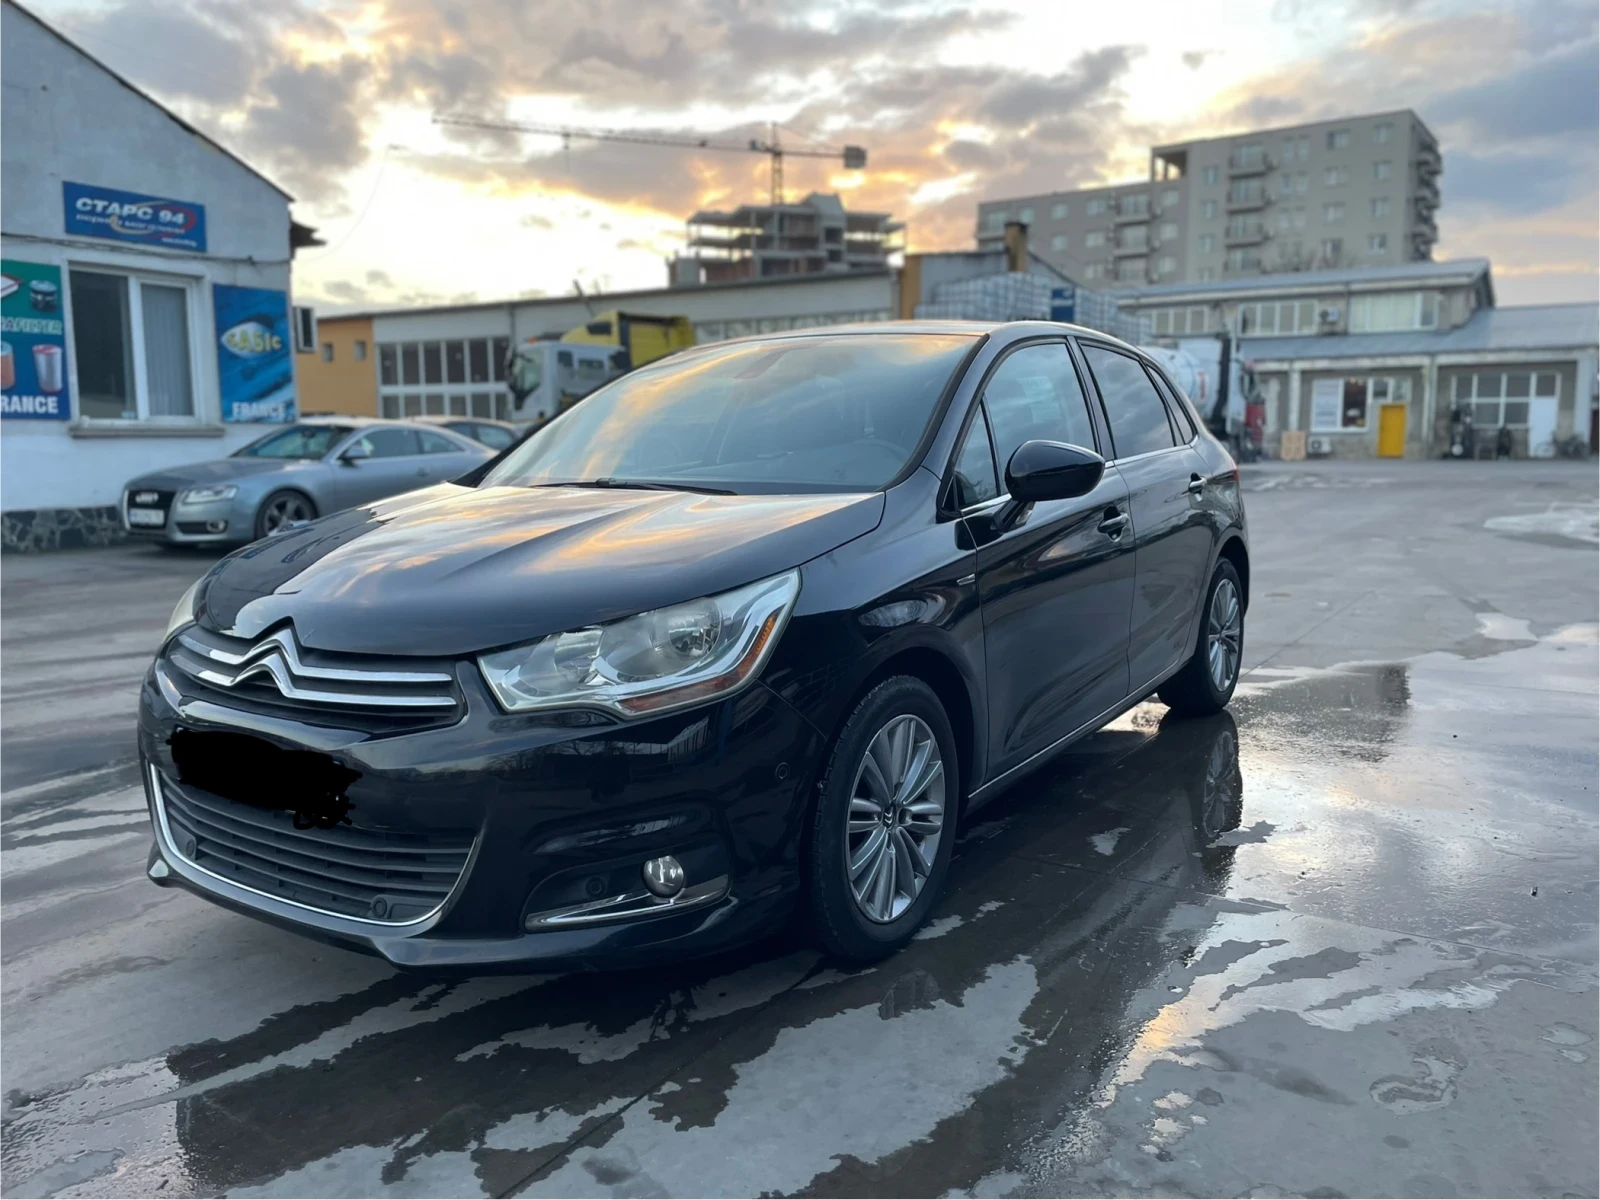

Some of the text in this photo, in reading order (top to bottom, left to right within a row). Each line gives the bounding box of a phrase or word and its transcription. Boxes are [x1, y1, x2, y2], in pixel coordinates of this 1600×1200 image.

[76, 198, 153, 220] СТАРС
[159, 210, 185, 224] 94
[232, 401, 285, 421] FRANCE
